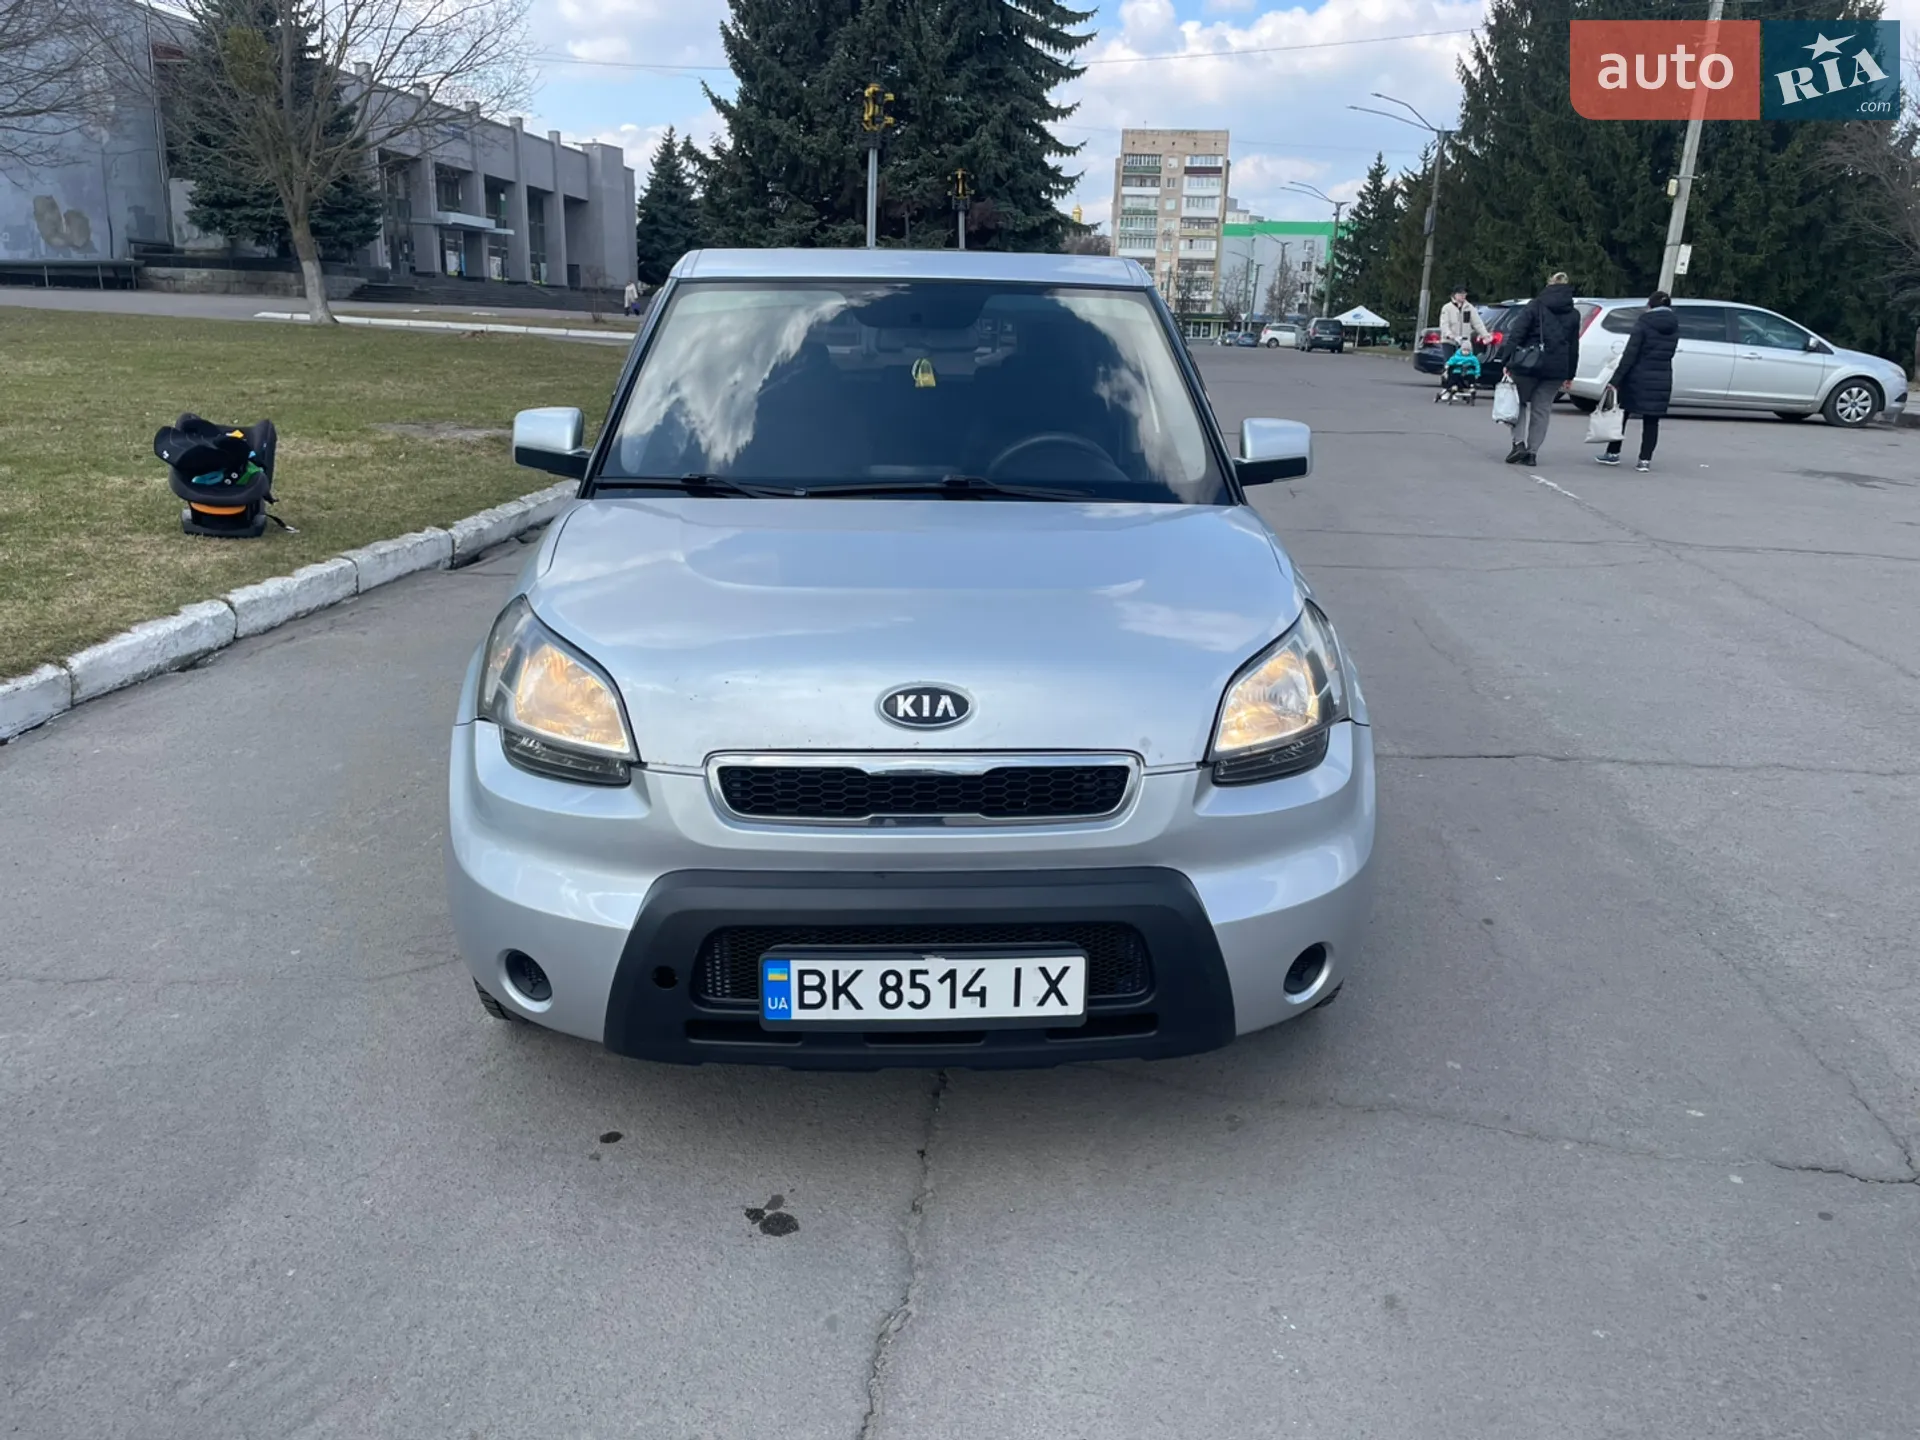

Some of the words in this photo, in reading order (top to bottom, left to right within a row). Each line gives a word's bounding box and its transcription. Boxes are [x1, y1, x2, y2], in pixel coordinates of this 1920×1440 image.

[896, 694, 957, 717] KIA
[797, 969, 864, 1010] BK
[878, 968, 987, 1010] 8514
[1013, 966, 1071, 1008] IX
[768, 997, 788, 1010] UA
